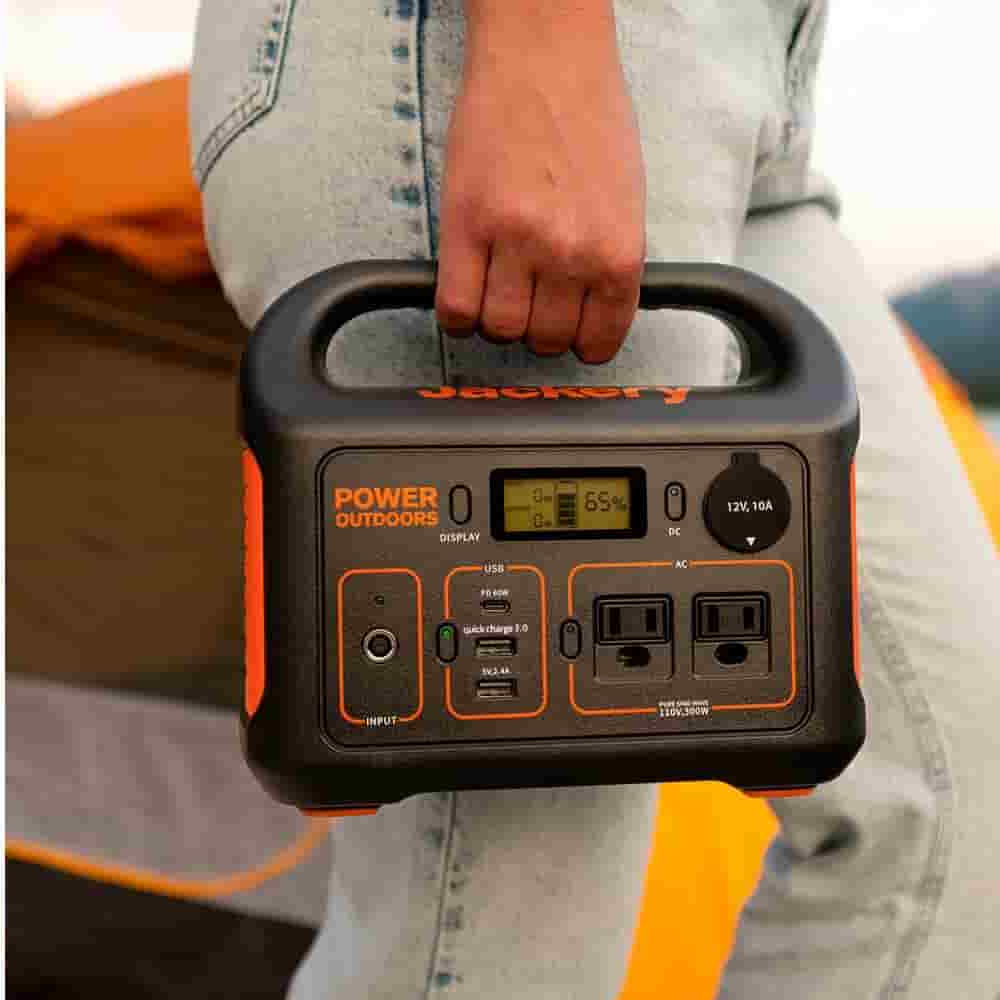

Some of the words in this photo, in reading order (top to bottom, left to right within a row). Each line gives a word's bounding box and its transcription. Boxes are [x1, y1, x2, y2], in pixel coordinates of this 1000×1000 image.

[335, 487, 439, 510] POWER
[335, 511, 439, 528] OUTDOORS
[668, 527, 681, 537] DC
[439, 532, 481, 544] DISPLAY
[484, 563, 505, 574] USB
[674, 560, 688, 569] AC
[366, 716, 397, 727] INPUT
